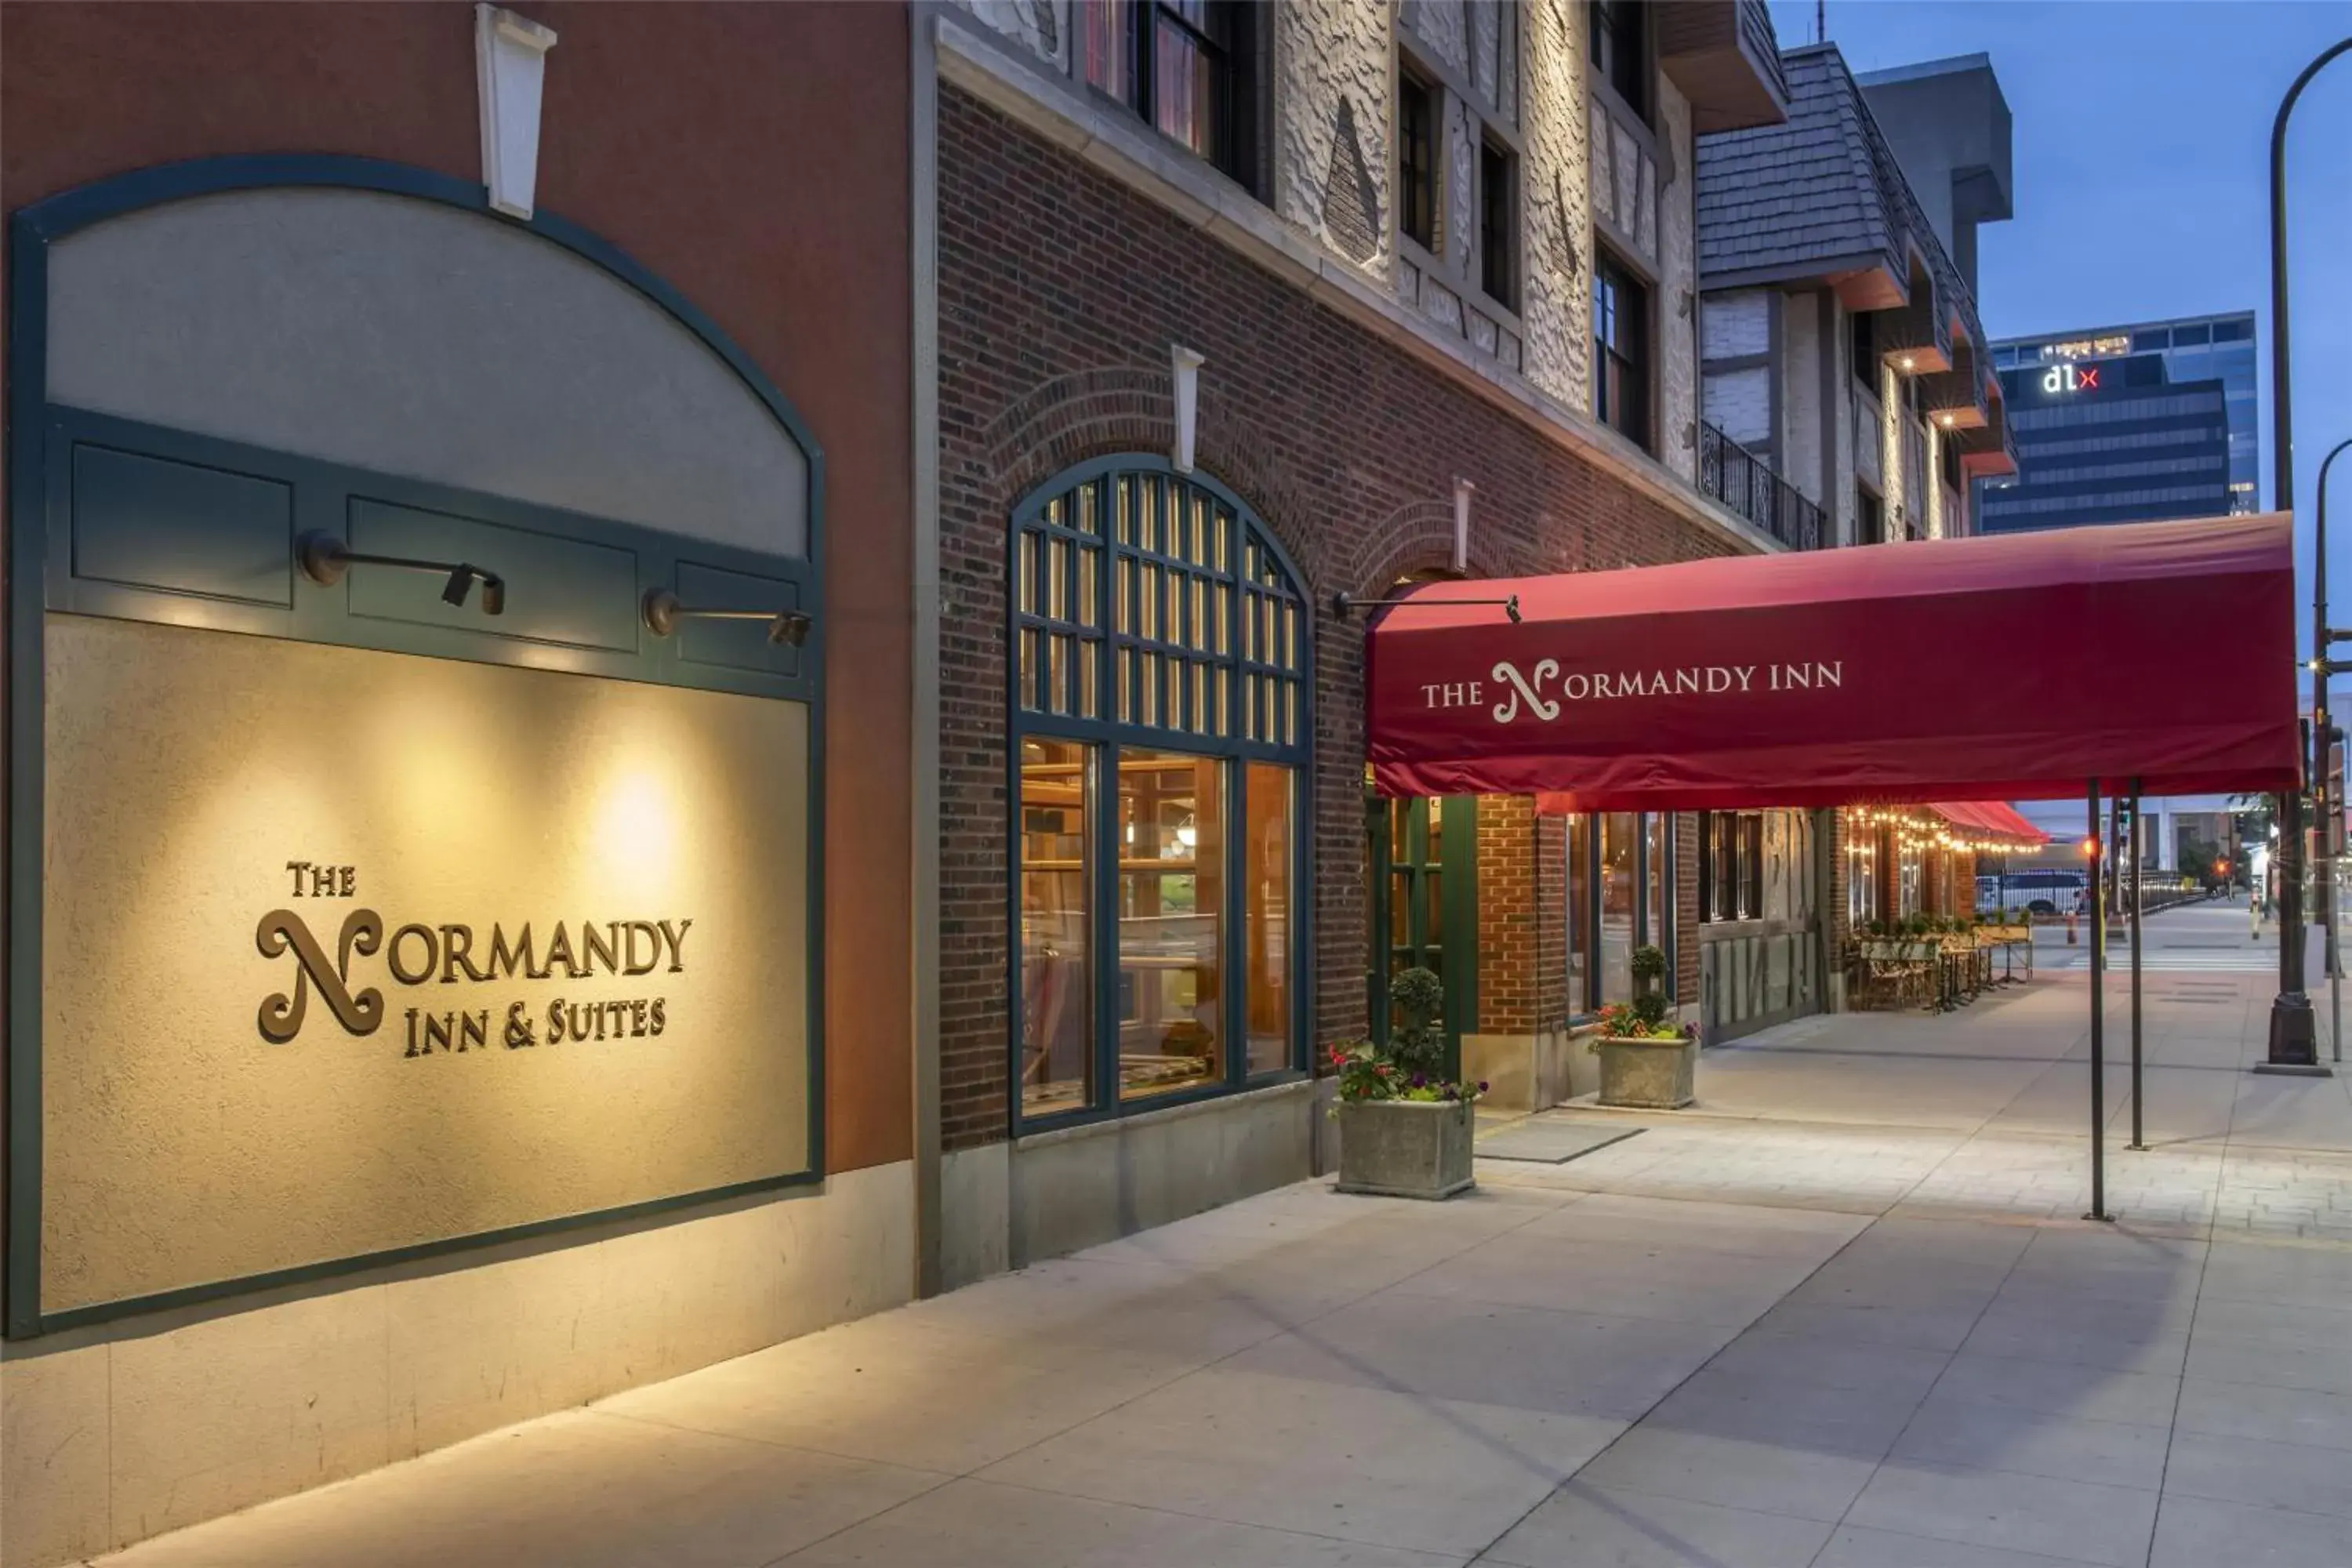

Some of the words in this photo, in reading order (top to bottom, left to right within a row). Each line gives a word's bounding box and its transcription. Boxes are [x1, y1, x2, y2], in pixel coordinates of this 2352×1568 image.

[2043, 364, 2098, 393] dlx
[1421, 681, 1483, 708] THE
[1492, 659, 1756, 724] NORMANDY
[1769, 661, 1843, 690] INN
[286, 861, 356, 898] THE
[256, 908, 693, 1044] NORMANDY
[404, 1007, 489, 1058] INN
[504, 1000, 535, 1049] &
[546, 997, 666, 1044] SUITES
